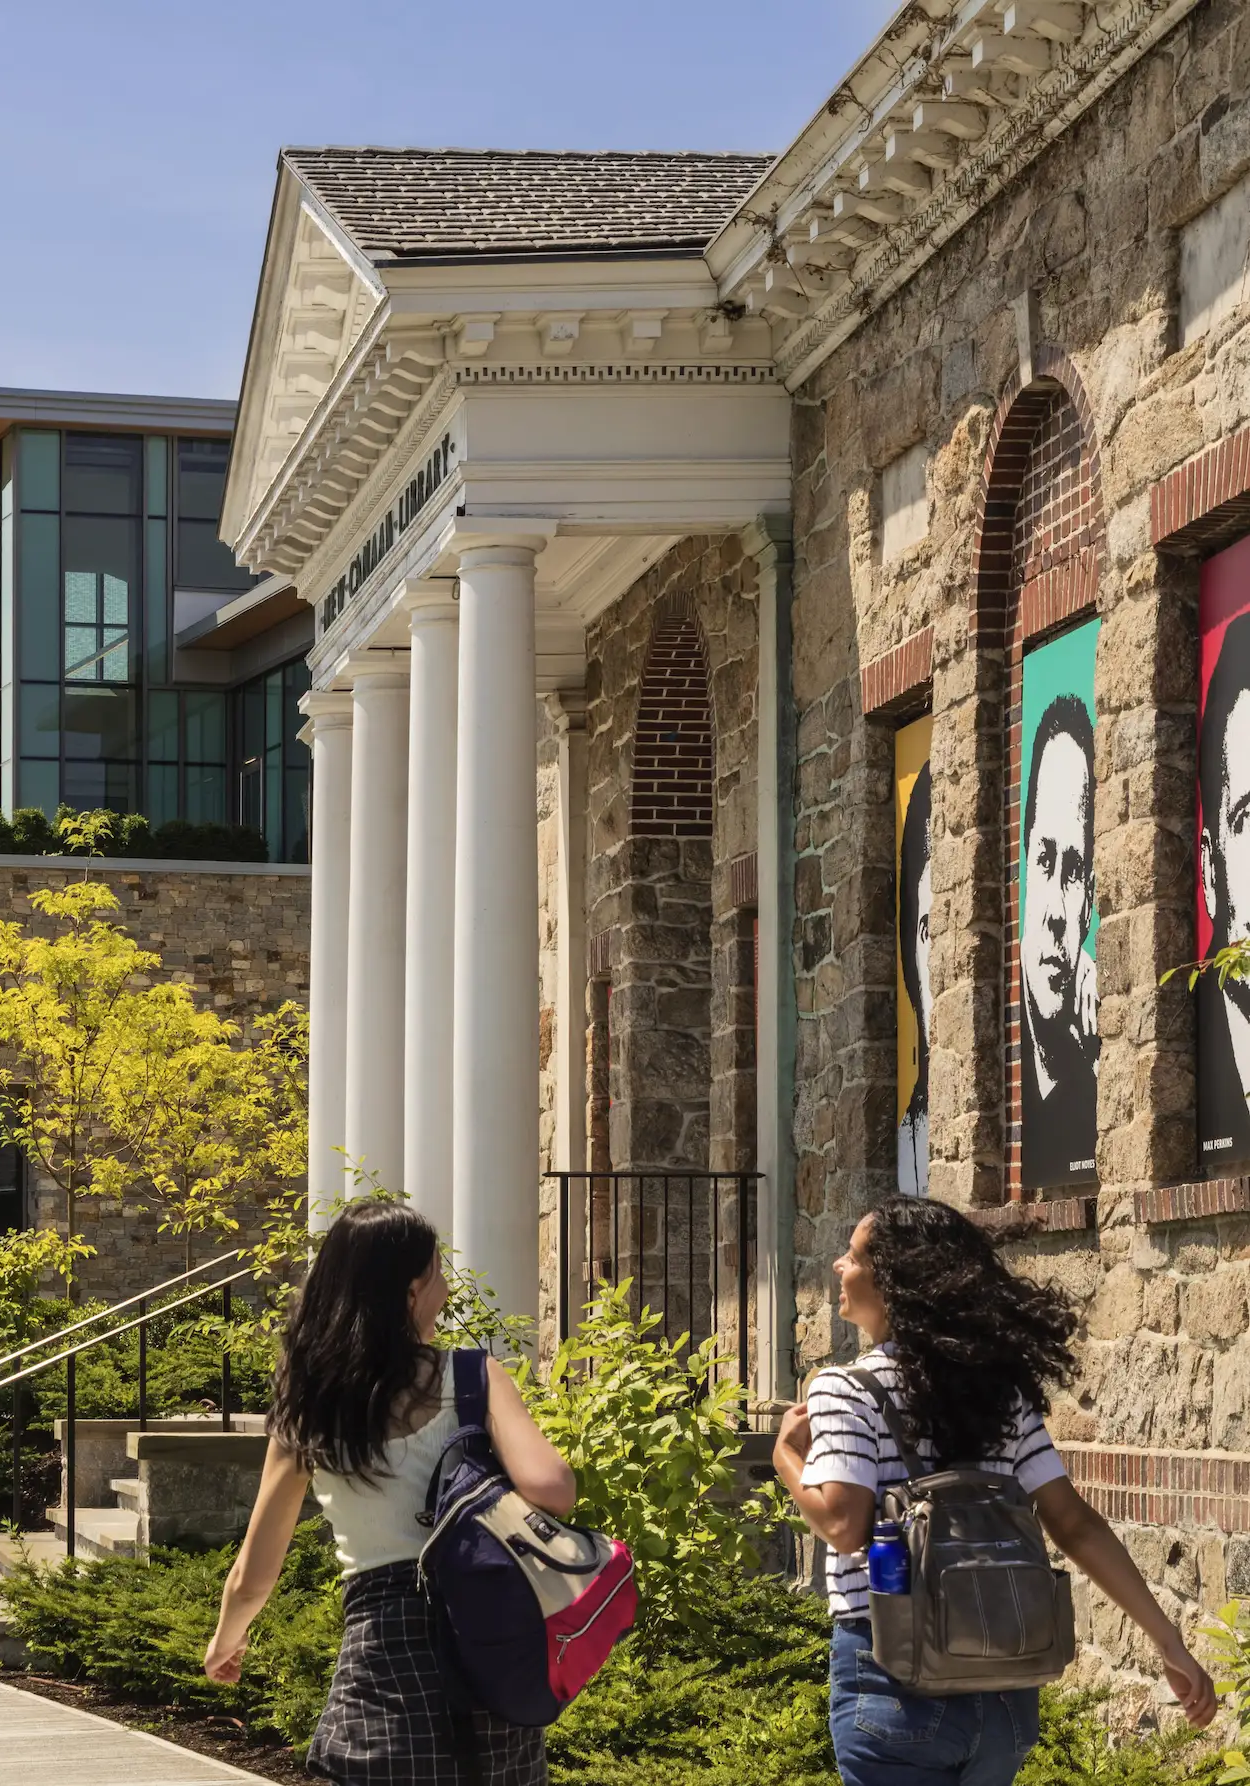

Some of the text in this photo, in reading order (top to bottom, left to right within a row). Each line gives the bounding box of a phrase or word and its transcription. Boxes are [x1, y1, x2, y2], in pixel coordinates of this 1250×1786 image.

[1202, 1136, 1233, 1152] MAX PERKINS
[1069, 1160, 1081, 1172] ELIOT
